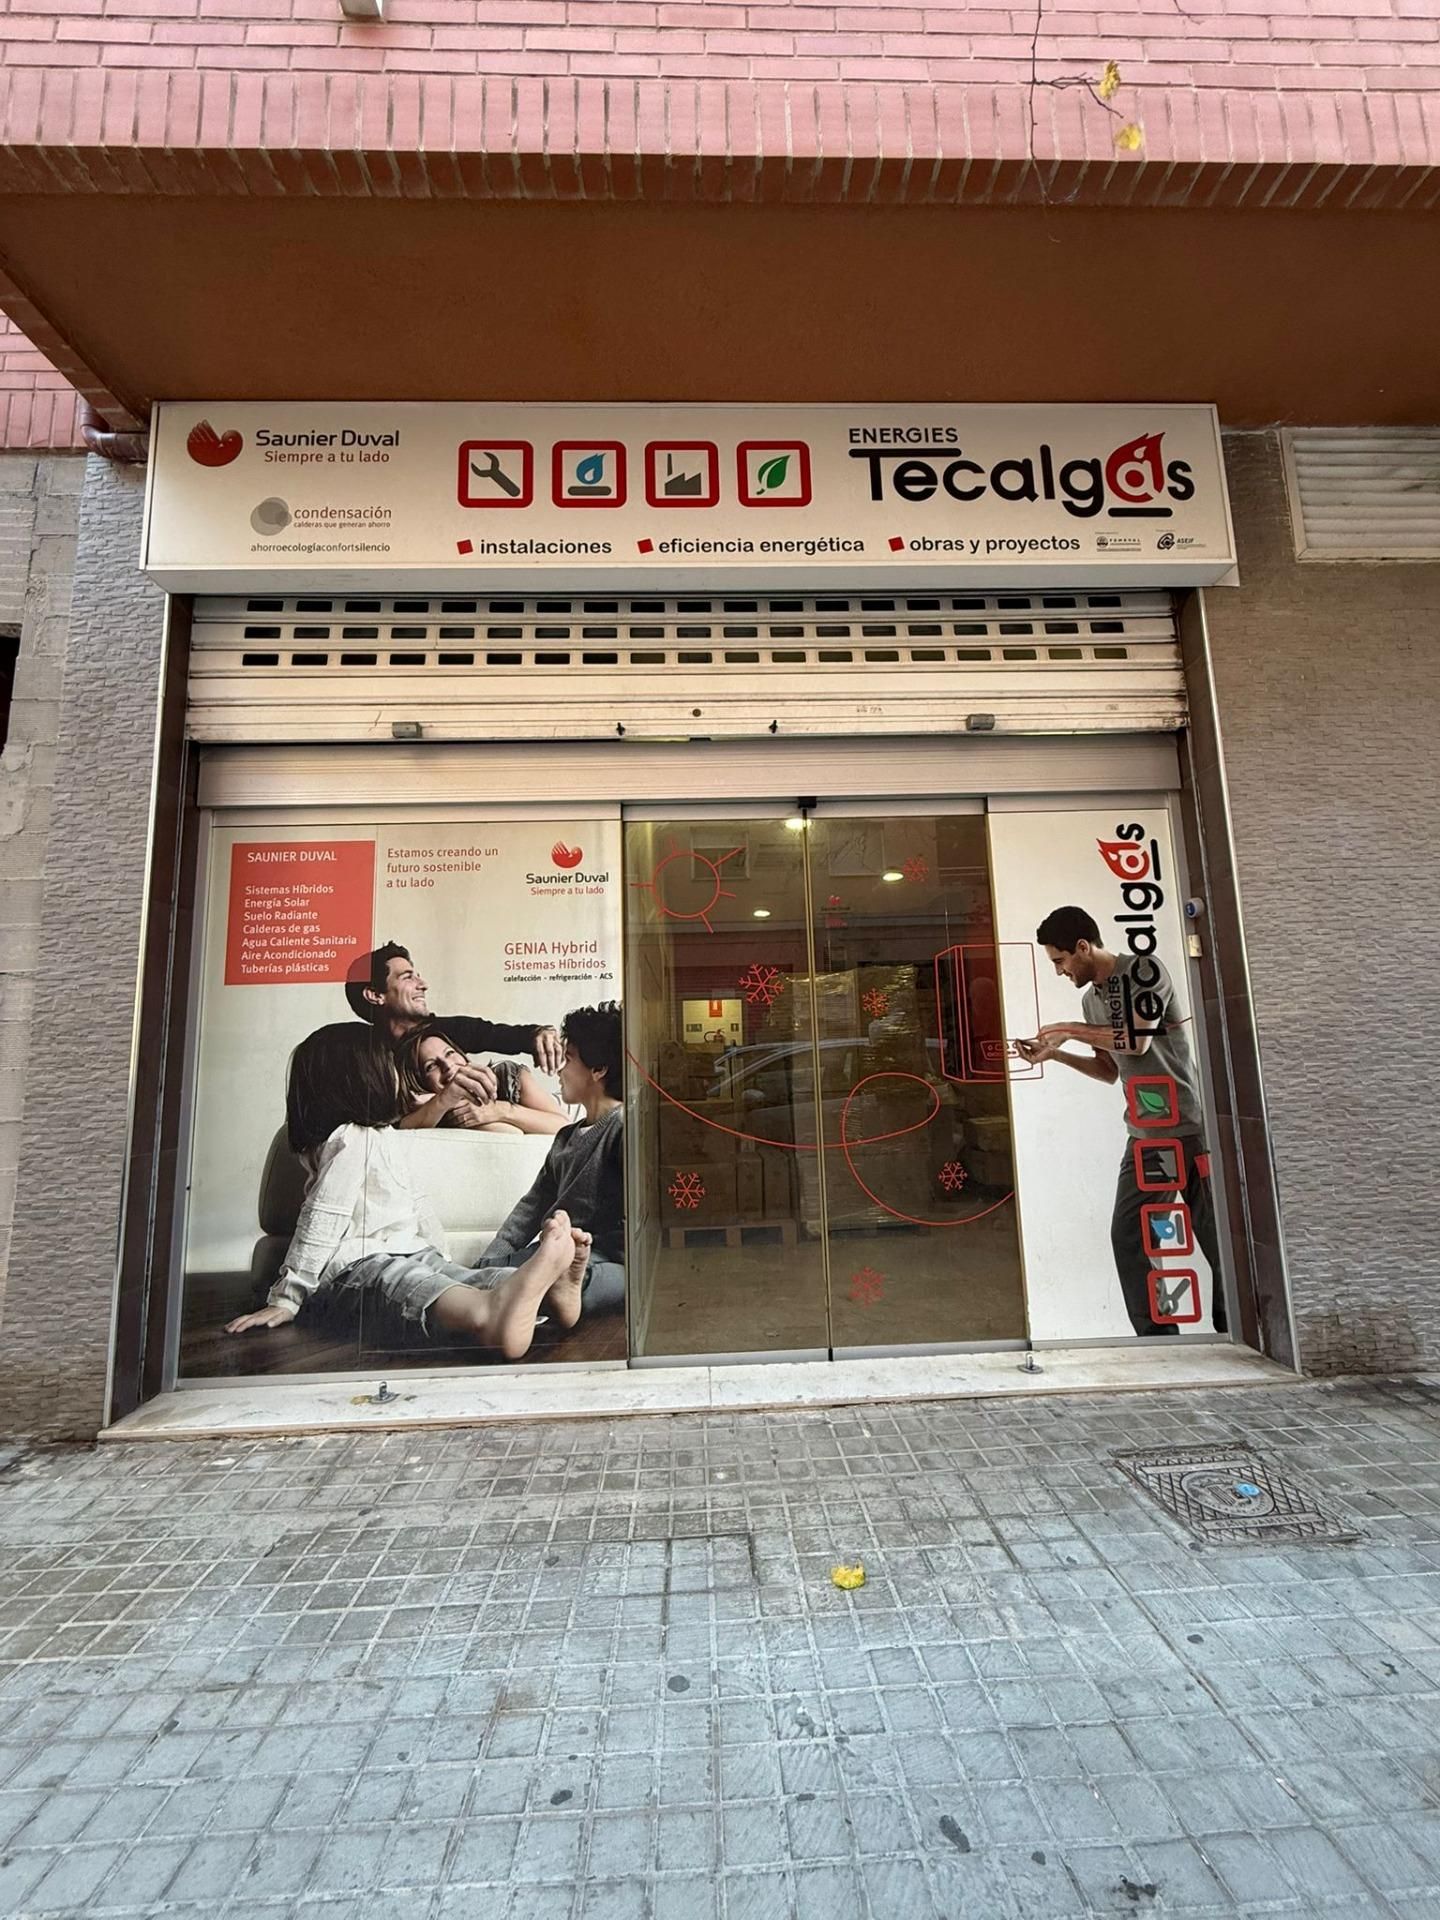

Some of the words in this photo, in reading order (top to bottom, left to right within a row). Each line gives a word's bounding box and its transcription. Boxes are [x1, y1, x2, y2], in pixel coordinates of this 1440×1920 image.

[256, 430, 337, 447] Saunier
[341, 430, 400, 447] Duval
[849, 427, 959, 444] ENERGIES
[264, 450, 323, 465] Siempre
[327, 453, 335, 463] a
[340, 451, 354, 463] tu
[359, 450, 390, 463] lado
[848, 431, 1196, 518] Tecalgas
[294, 505, 392, 519] condensación
[250, 542, 391, 553] ahorroecologíaconfortsilencio
[480, 538, 612, 554] instalaciones
[658, 536, 754, 553] eficiencia
[760, 536, 865, 556] energética
[909, 537, 964, 552] obras
[969, 541, 981, 555] y
[986, 535, 1081, 554] proyectos
[247, 851, 296, 863] SAUNIER
[299, 850, 338, 862] DUVAL
[387, 847, 434, 858] Estamos
[437, 846, 482, 857] creando
[484, 847, 499, 856] un
[386, 862, 420, 873] futuro
[423, 861, 481, 872] sostenible
[386, 880, 393, 888] a
[396, 878, 407, 888] tu
[410, 876, 435, 888] lado
[525, 873, 573, 884] Saunier
[575, 871, 609, 883] Duval
[245, 885, 290, 896] Sistemas
[292, 883, 335, 895] Híbridos
[530, 886, 566, 896] Siempre
[575, 887, 584, 895] tu
[585, 885, 605, 894] lado
[244, 898, 281, 909] Energía
[284, 897, 310, 908] Solar
[244, 911, 272, 921] Suelo
[274, 910, 319, 920] Radiante
[243, 924, 286, 934] Calderas
[288, 923, 301, 933] de
[303, 925, 321, 935] gas
[241, 937, 268, 949] Agua
[269, 936, 311, 947] Caliente
[312, 935, 357, 946] Sanitaria
[1096, 822, 1168, 1051] Tecalgas
[241, 950, 262, 961] Aire
[263, 949, 337, 960] Acondicionado
[504, 942, 548, 956] GENIA
[551, 940, 598, 957] Hybrid
[241, 964, 283, 974] Tuberías
[285, 962, 330, 975] plásticas
[504, 959, 556, 971] Sistemas
[559, 958, 607, 969] Híbridos
[503, 974, 541, 982] calefacción
[549, 973, 593, 982] refrigeración
[599, 972, 614, 980] ACS
[1107, 975, 1126, 1051] ENERGIES
